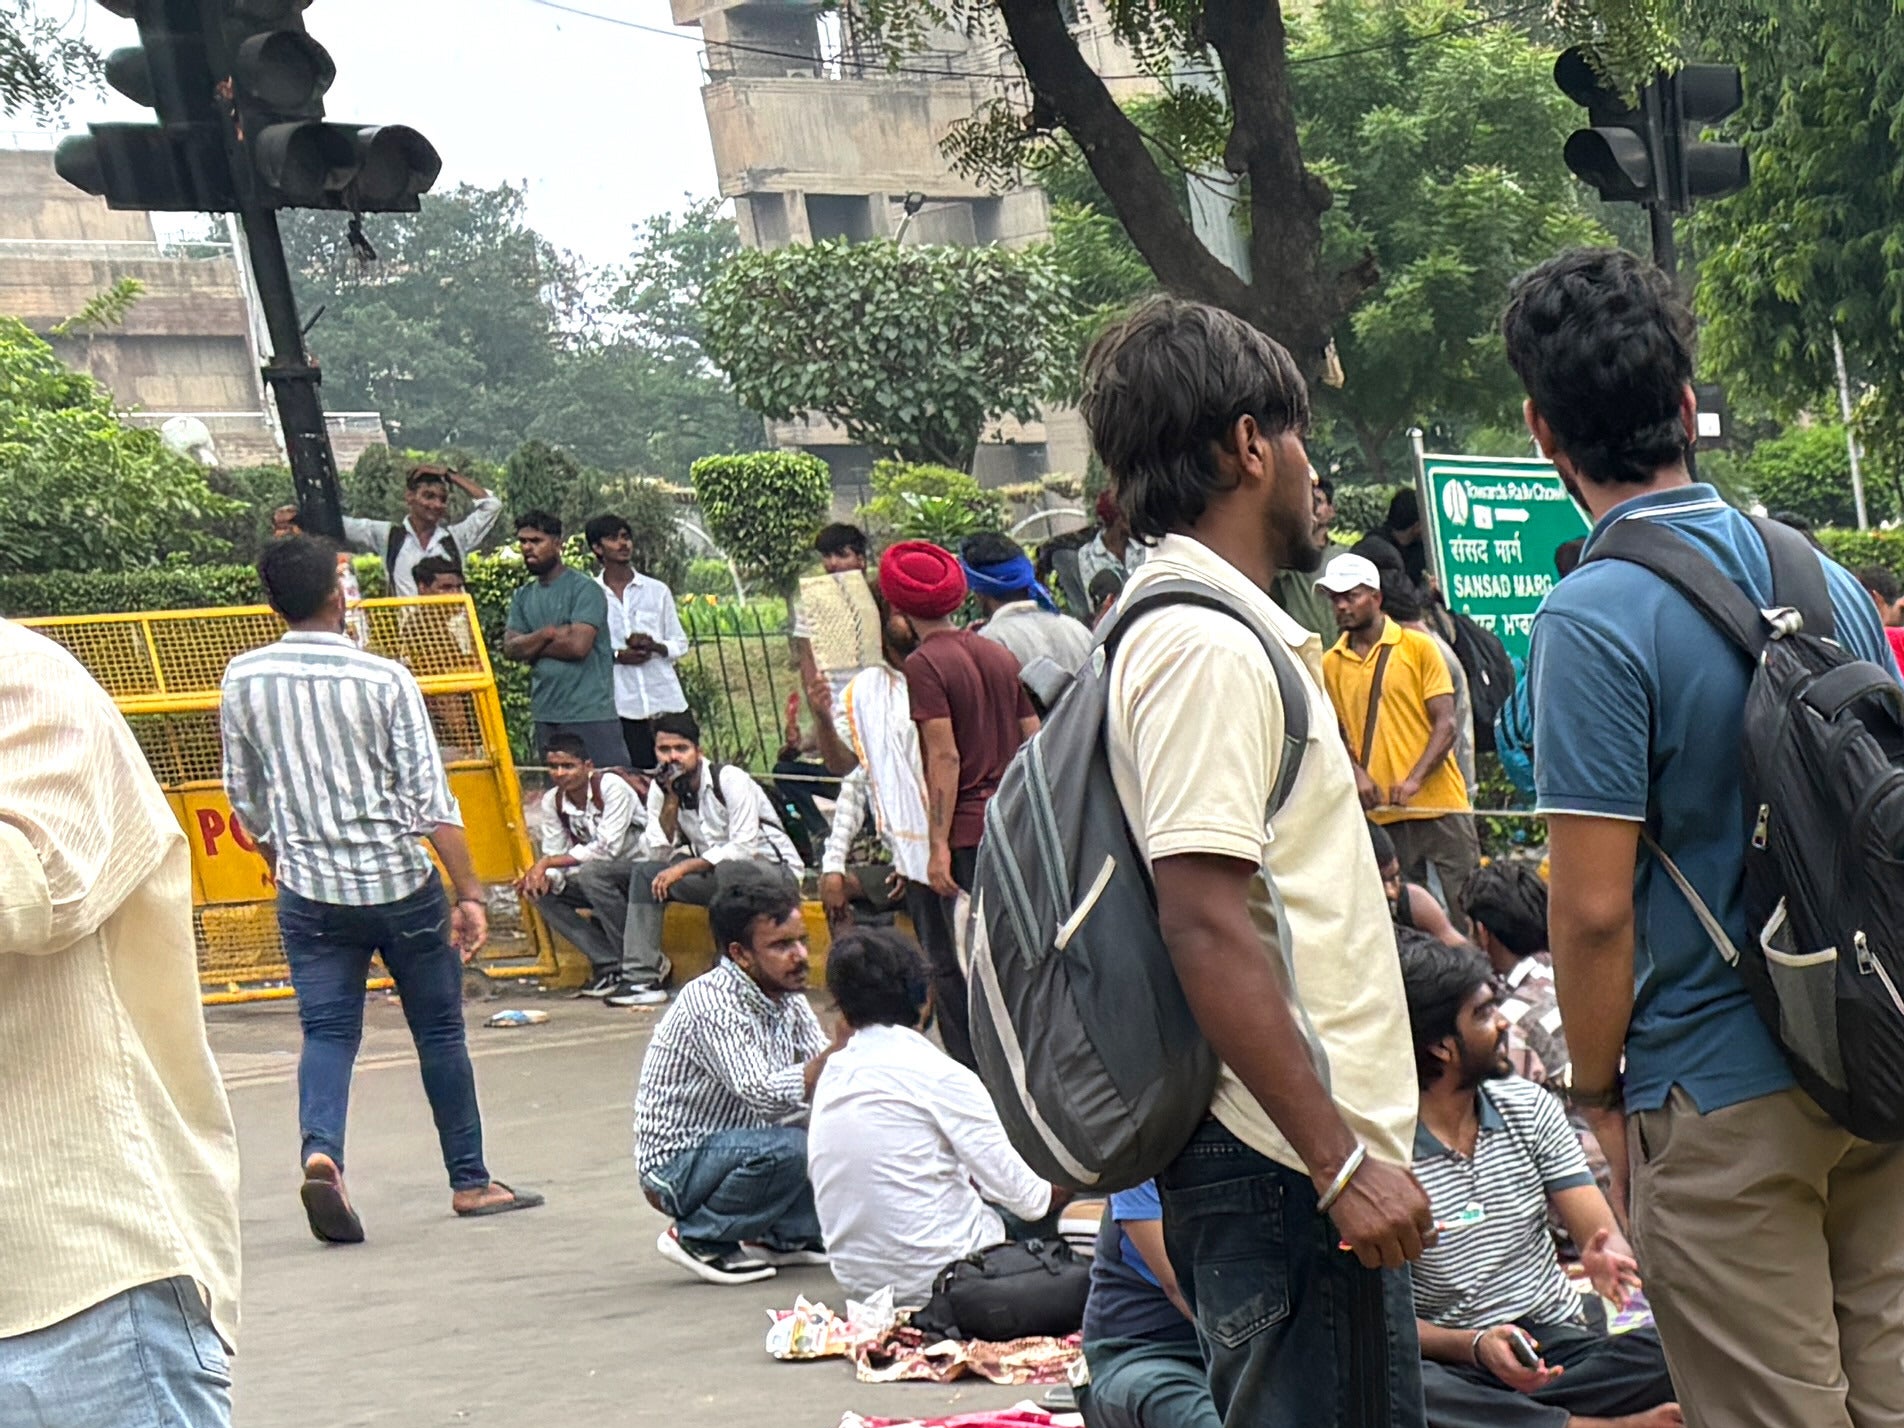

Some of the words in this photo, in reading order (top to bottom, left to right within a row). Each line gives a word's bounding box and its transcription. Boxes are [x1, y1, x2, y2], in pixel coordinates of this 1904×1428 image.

[1449, 534, 1488, 564] संसद
[1454, 573, 1511, 598] SANSAD
[1513, 574, 1553, 597] MARG
